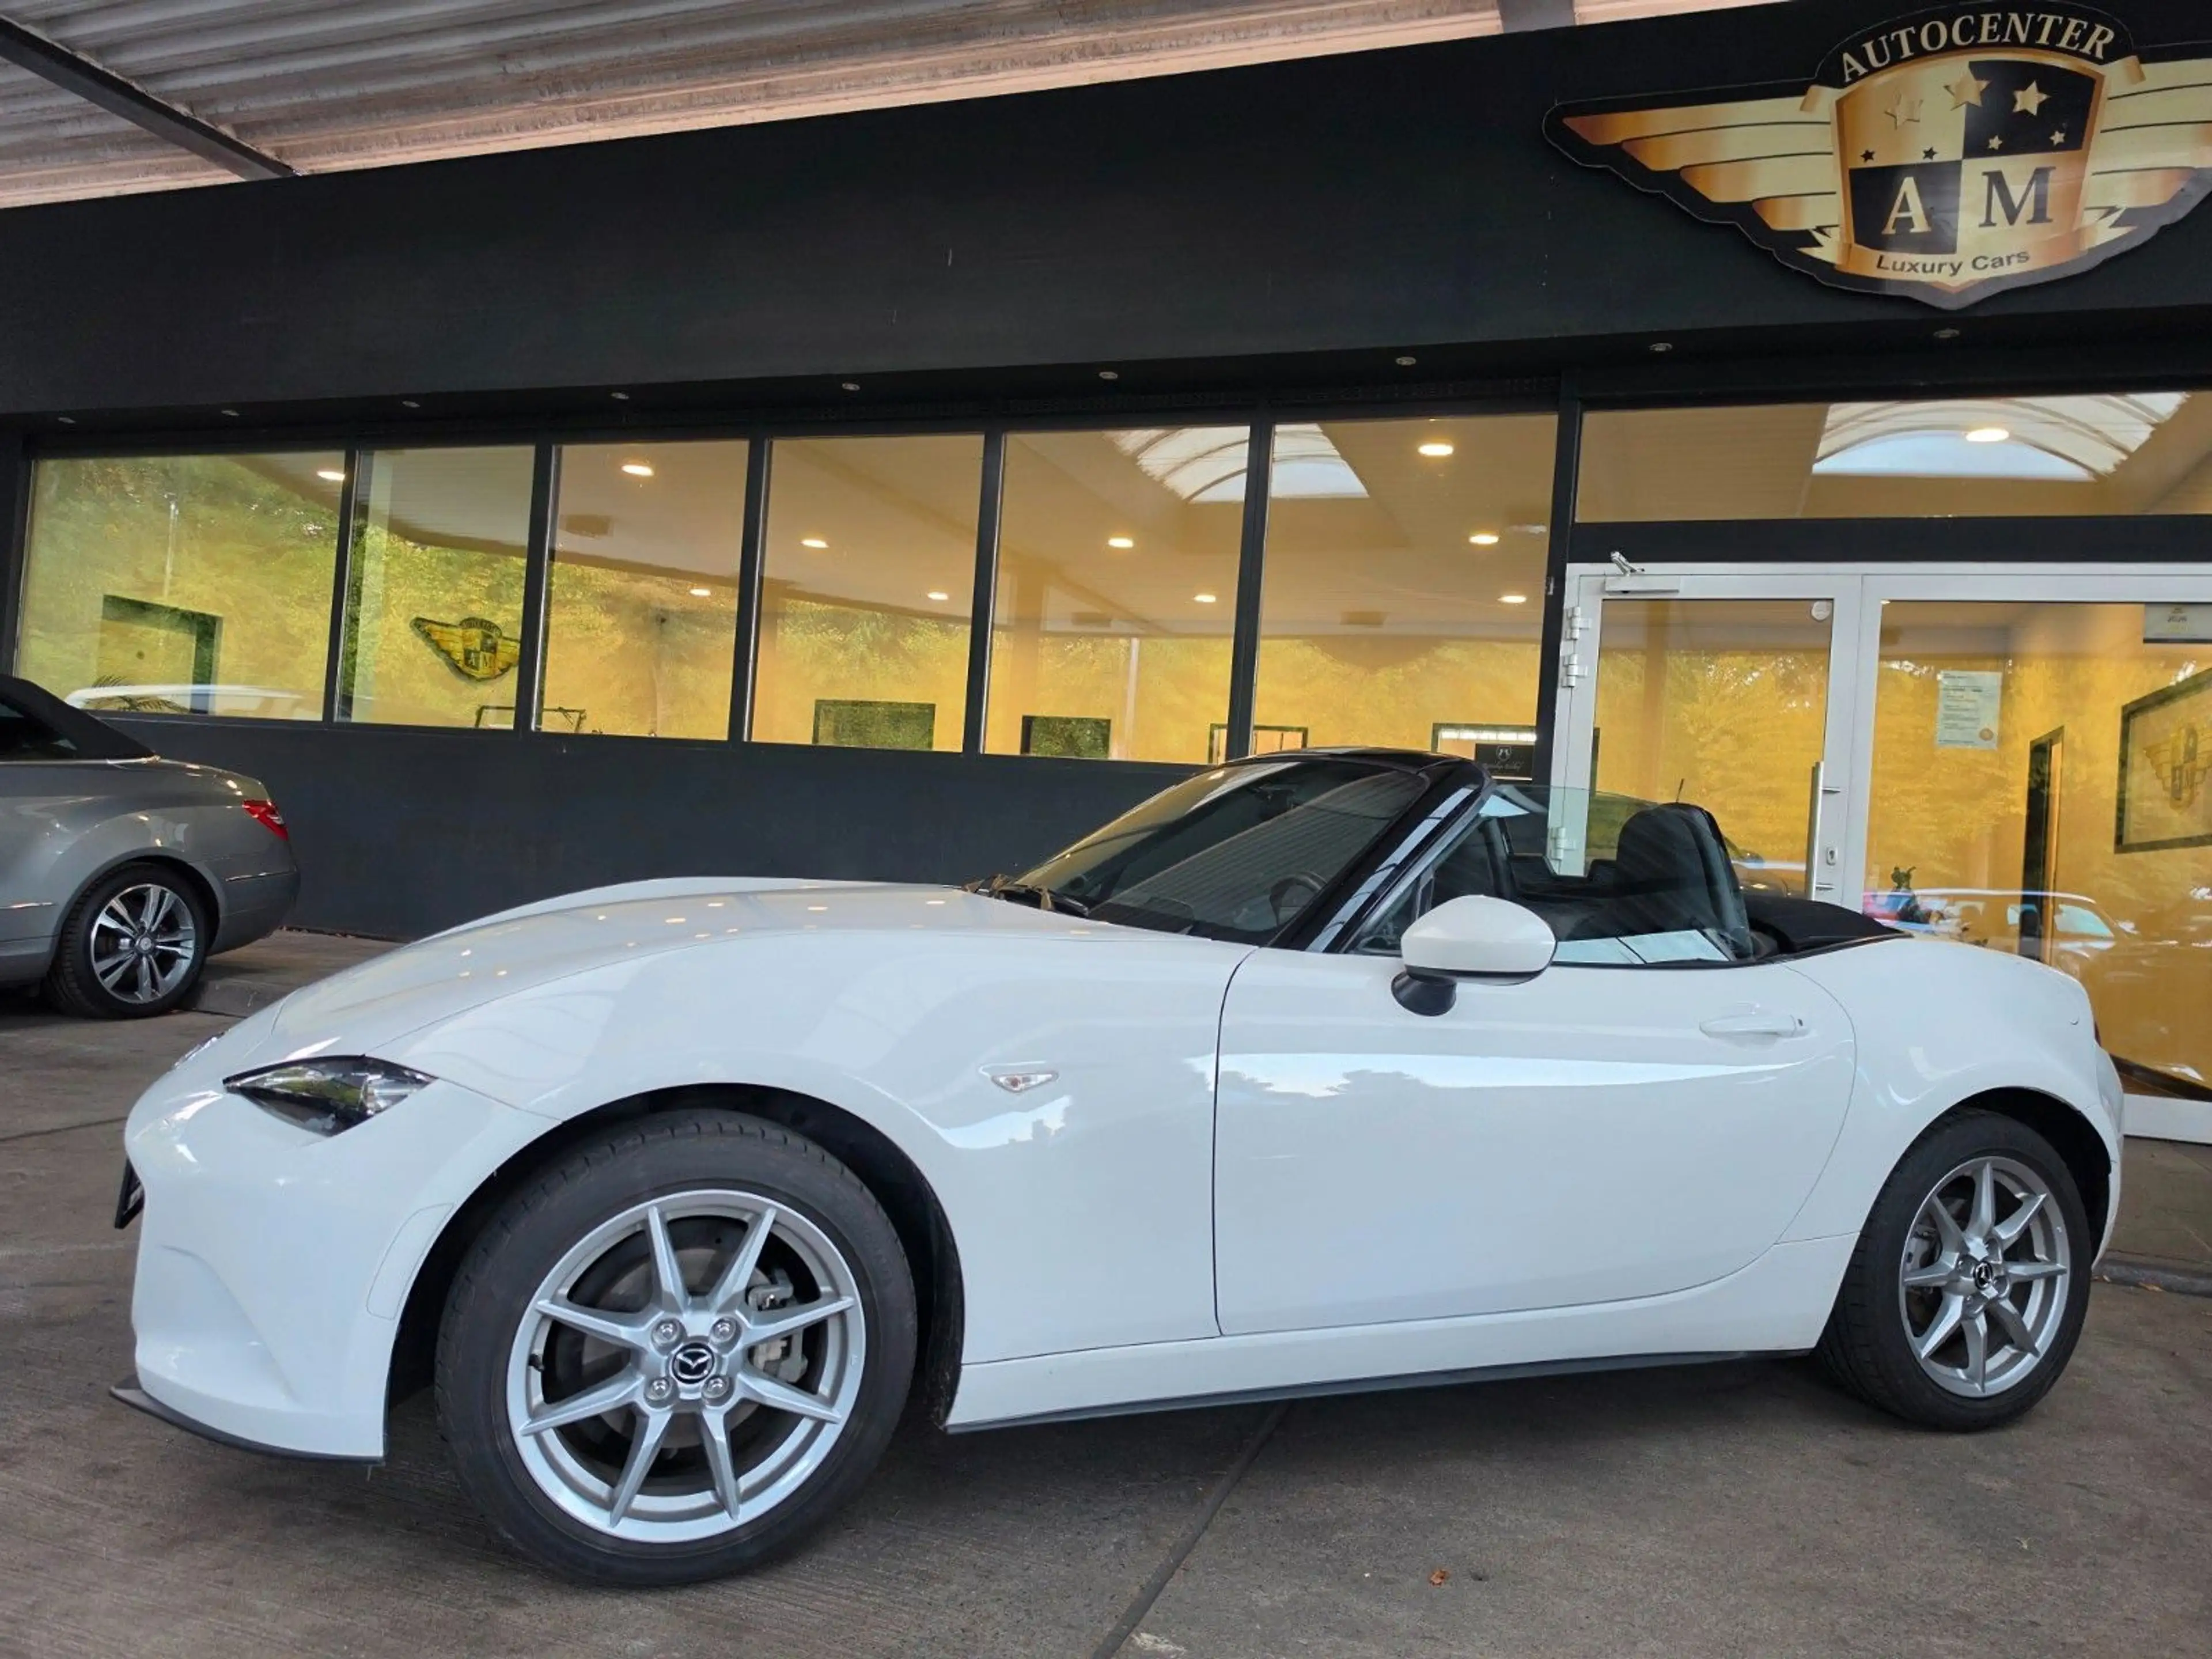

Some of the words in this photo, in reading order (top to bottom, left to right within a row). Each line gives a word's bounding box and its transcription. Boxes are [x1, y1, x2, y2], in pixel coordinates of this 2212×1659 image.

[1843, 12, 2115, 82] AUTOCENTER
[1881, 176, 1931, 234] A
[1978, 166, 2056, 228] M
[1876, 254, 1963, 276] Luxury
[1972, 249, 2030, 271] Cars
